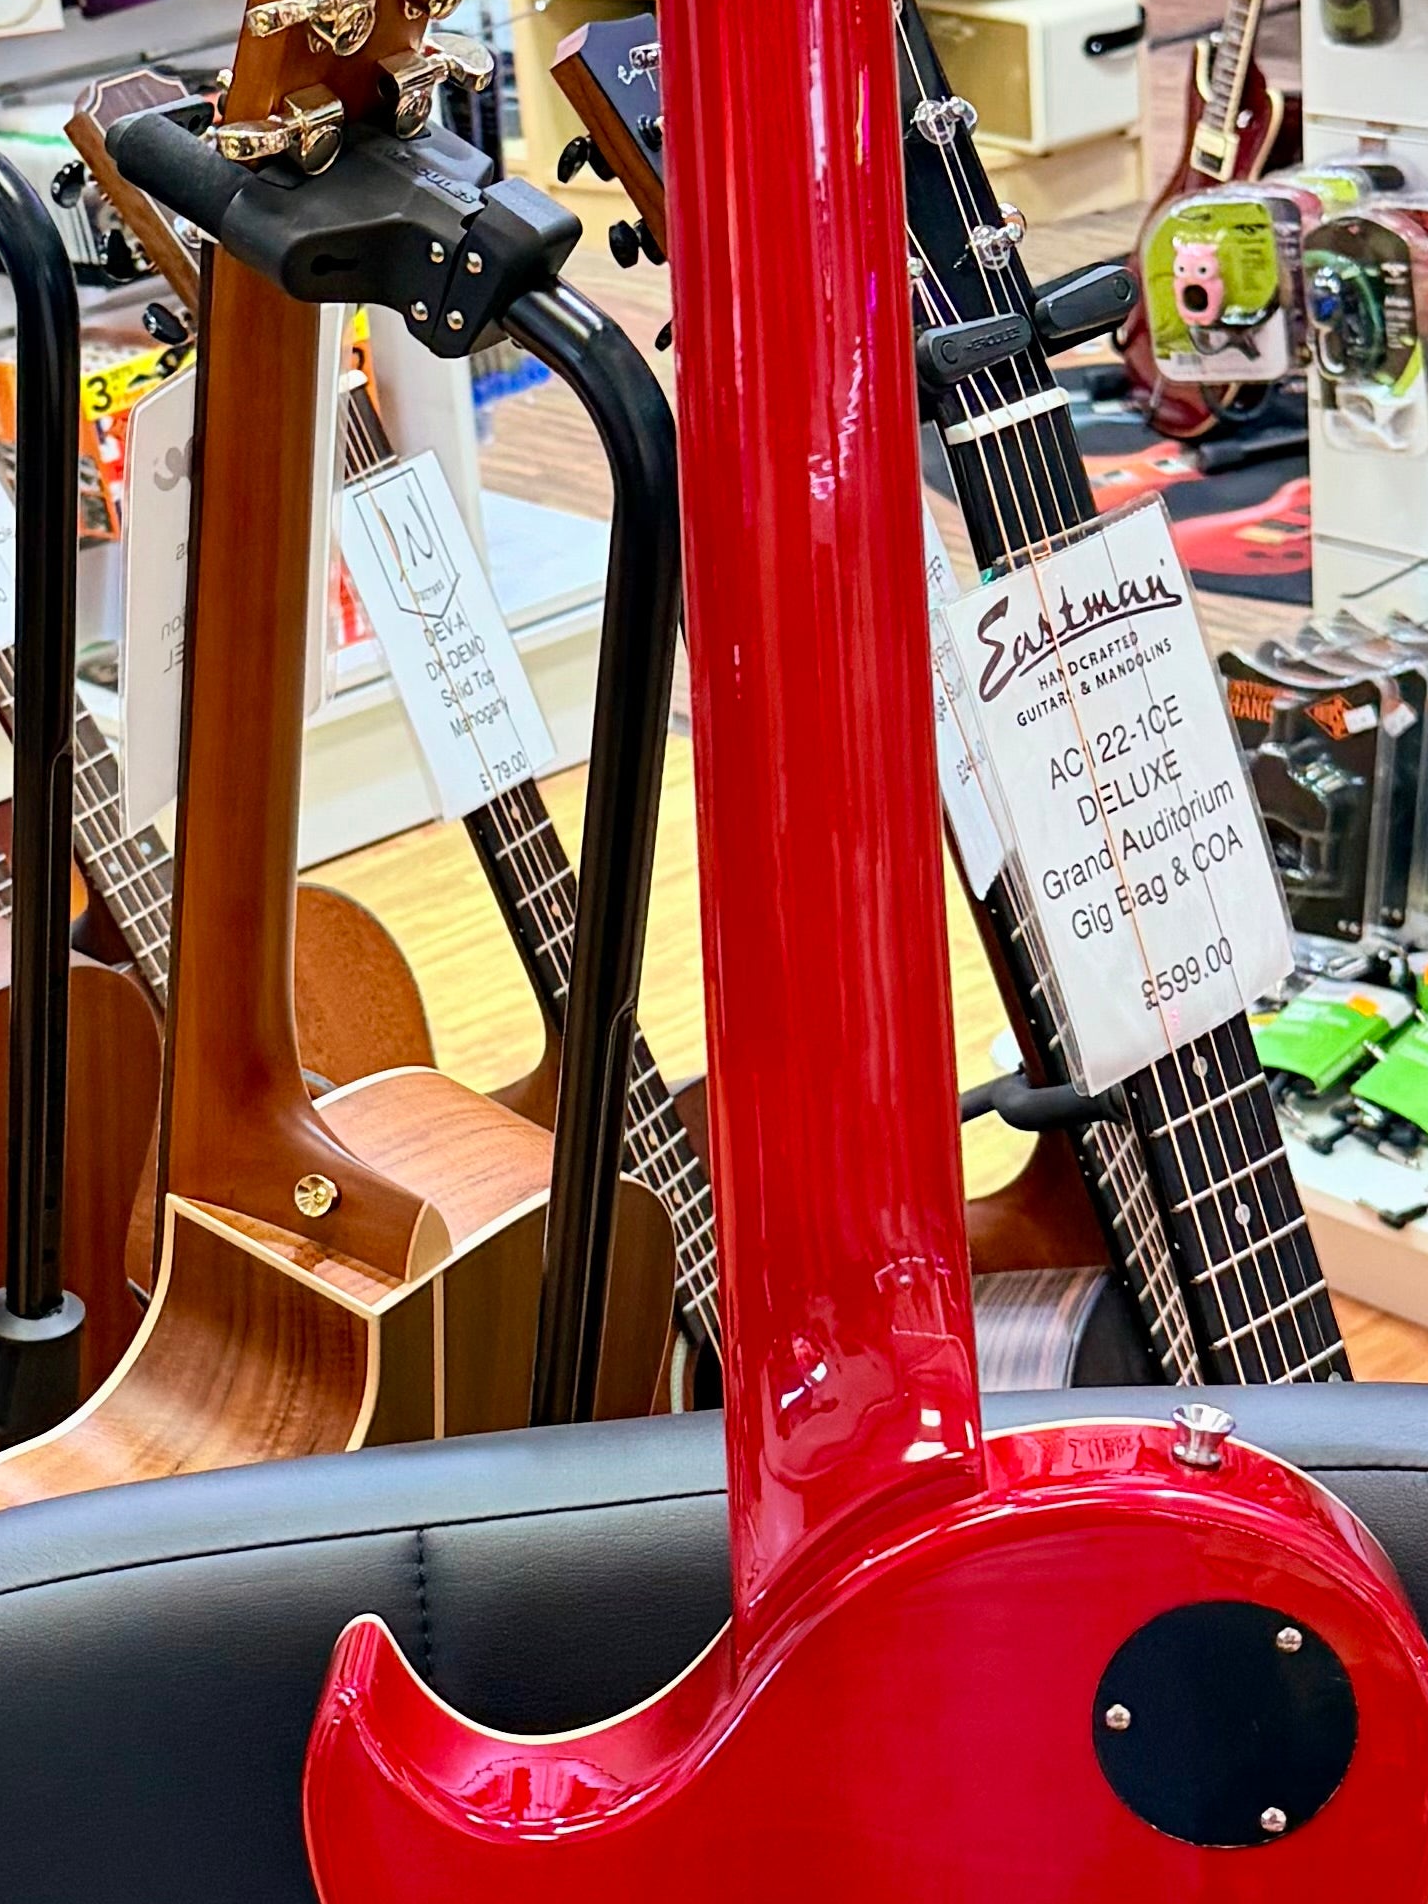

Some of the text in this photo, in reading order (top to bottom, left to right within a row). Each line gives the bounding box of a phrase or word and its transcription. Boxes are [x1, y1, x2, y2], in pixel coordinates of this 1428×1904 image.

[85, 375, 112, 413] 3
[423, 615, 469, 648] DEV-A
[425, 634, 486, 683] DX-DEMO
[977, 572, 1183, 703] Eastman
[1037, 631, 1139, 691] HANDCRAFTED
[440, 668, 497, 710] Solid Top
[1016, 637, 1173, 728] GUITARS & MANDOLINS
[449, 695, 510, 740] Mahogany
[1049, 693, 1184, 791] AC122-1CE
[479, 750, 528, 792] £79.00
[1076, 748, 1183, 828] DELUXE
[1042, 779, 1235, 902] Grand Auditorium
[1071, 823, 1245, 941] Gig Bag & COA
[1141, 935, 1234, 1012] £599.00
